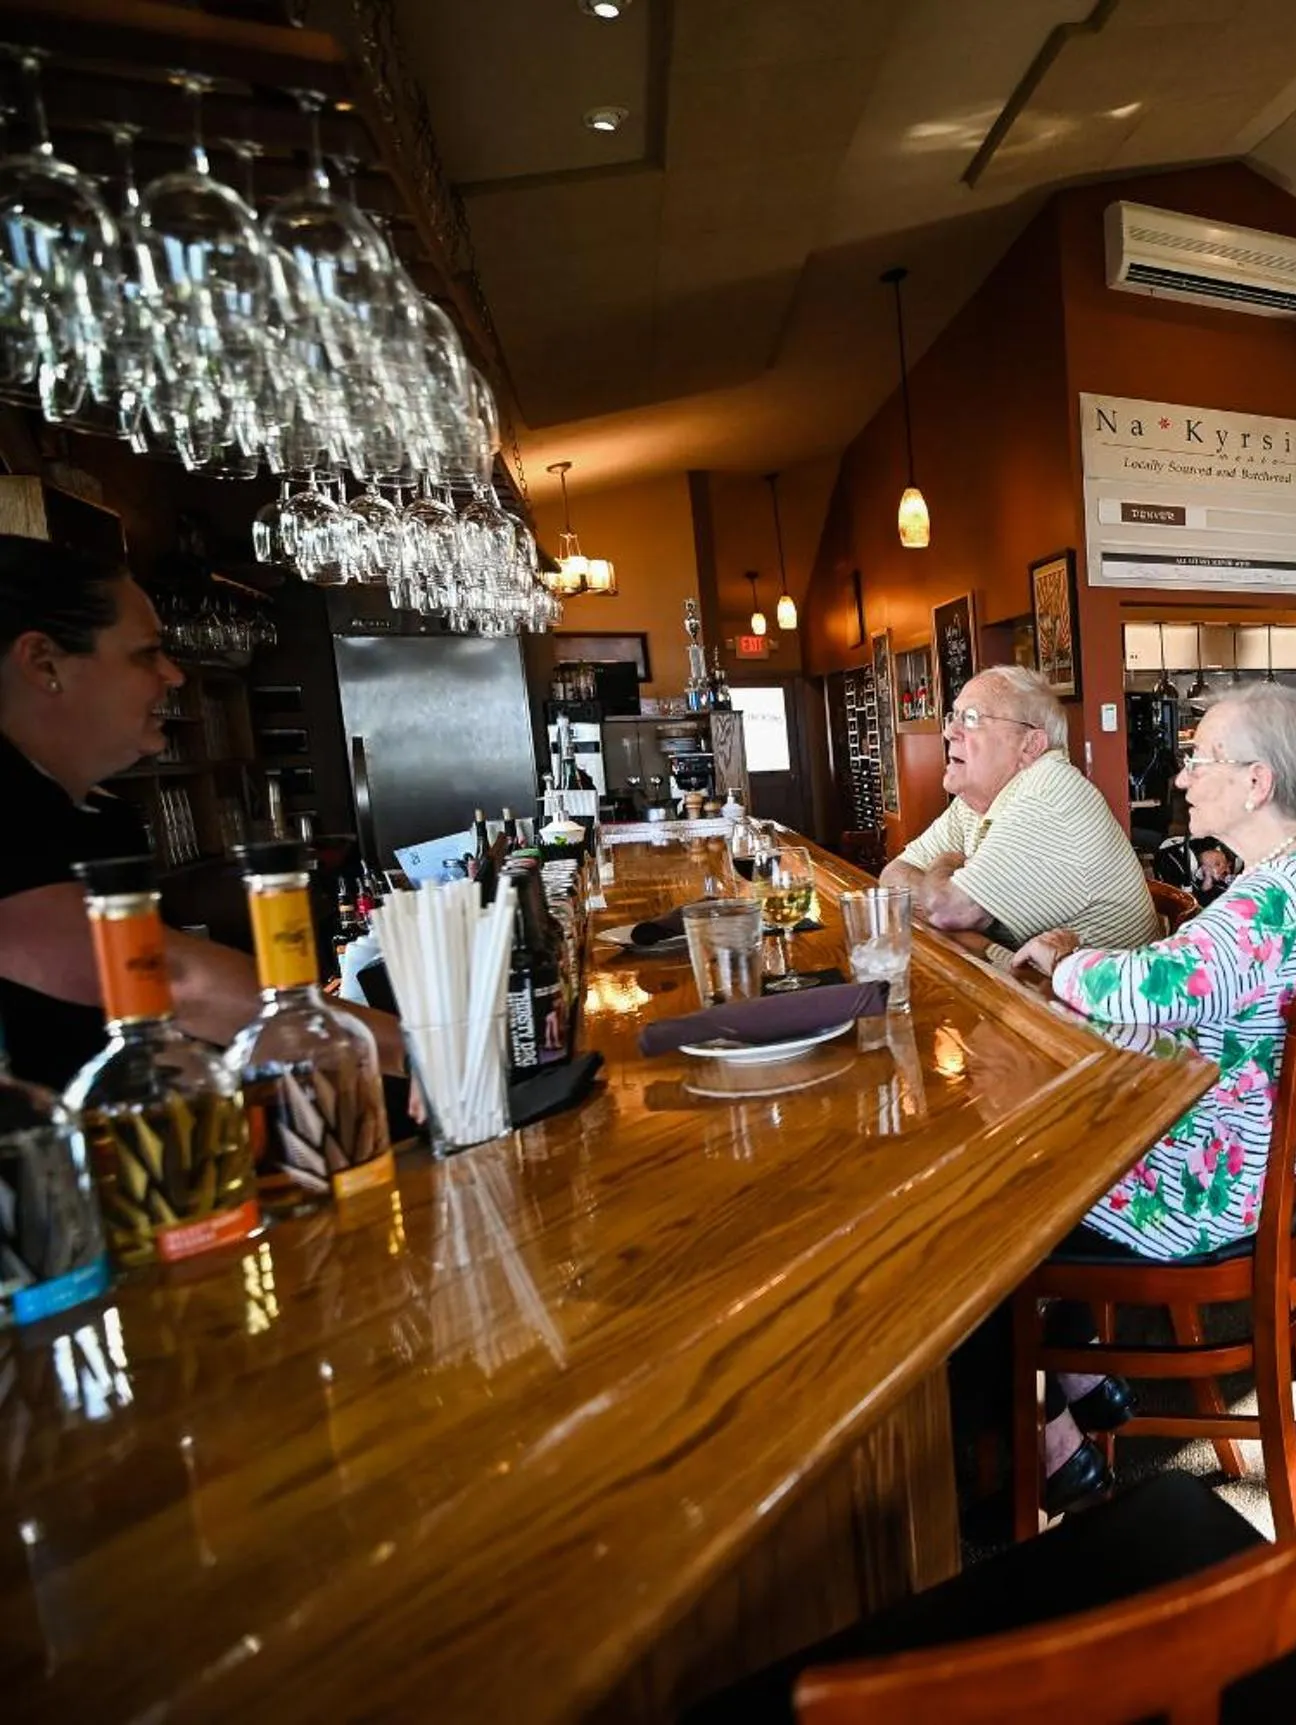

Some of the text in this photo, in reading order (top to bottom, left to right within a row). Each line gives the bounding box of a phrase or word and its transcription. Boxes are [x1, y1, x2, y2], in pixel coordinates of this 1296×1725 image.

[1095, 407, 1144, 437] Na
[1123, 457, 1292, 484] Locally Sourced and Butchered
[1131, 508, 1176, 521] DENVER
[740, 636, 765, 653] EXIT
